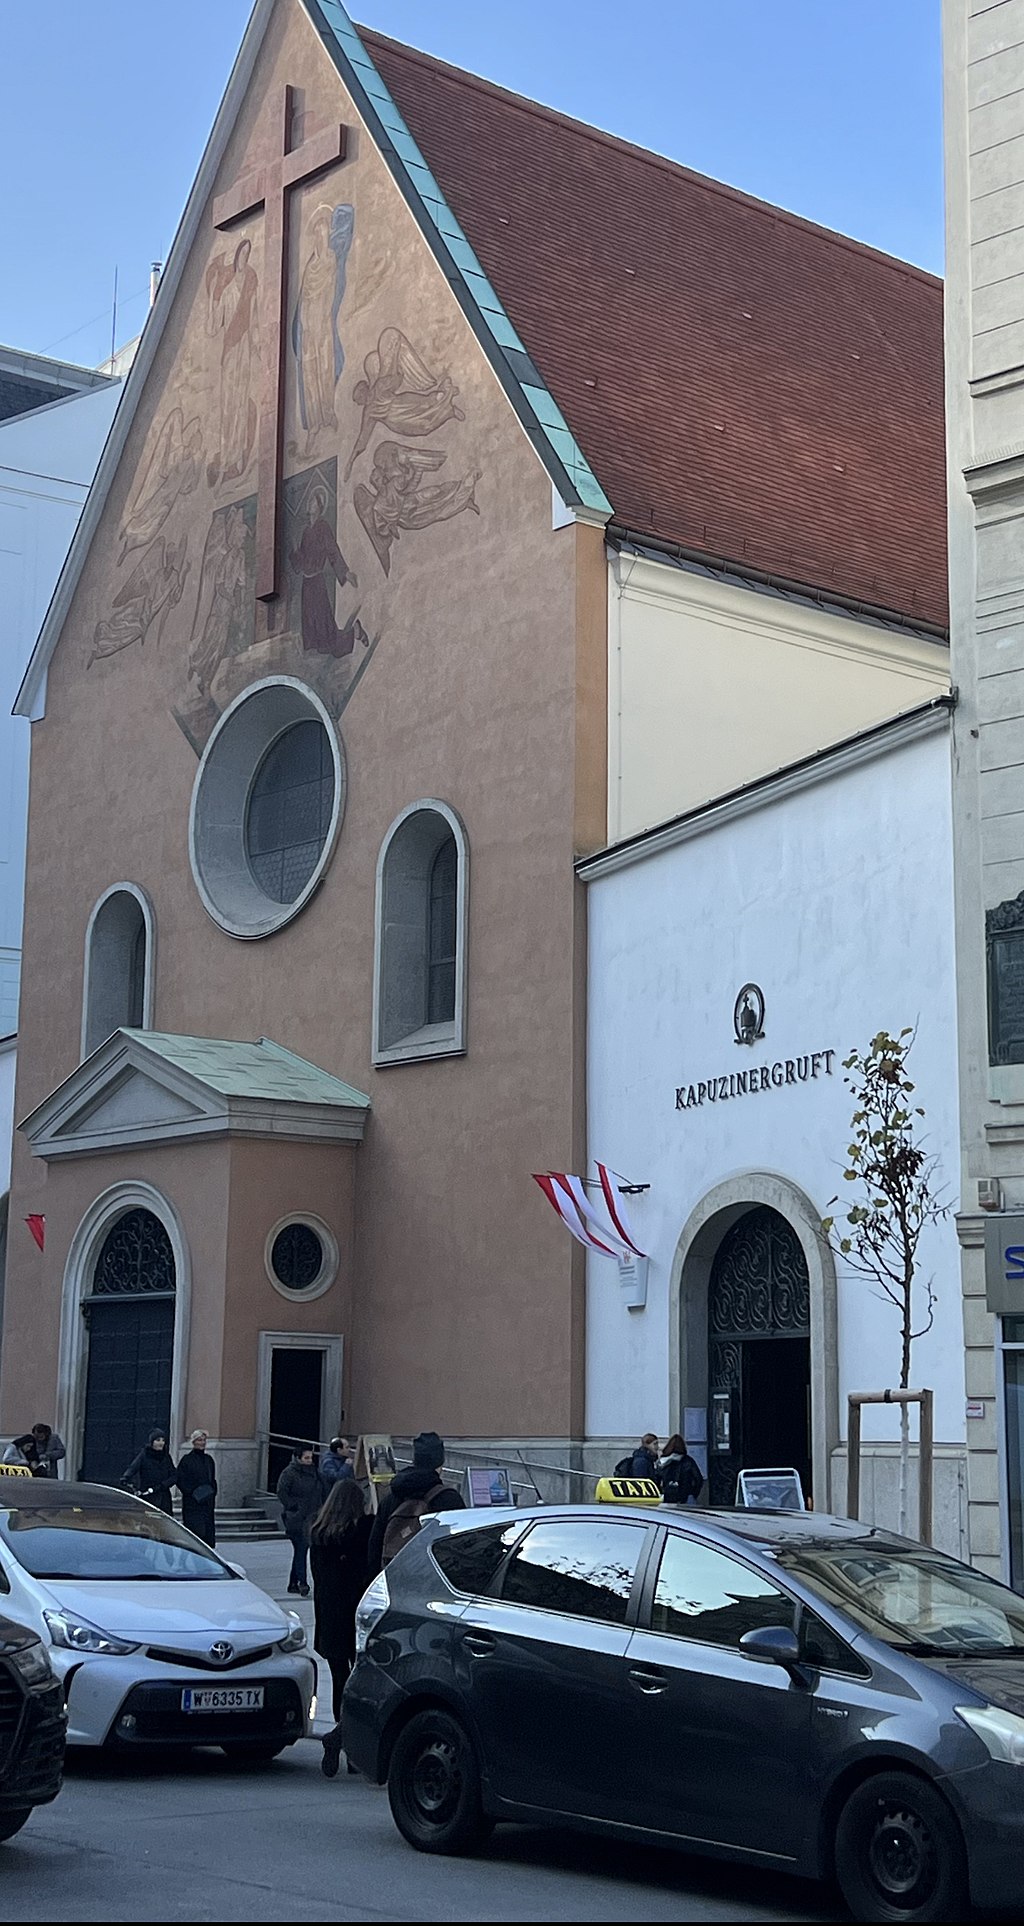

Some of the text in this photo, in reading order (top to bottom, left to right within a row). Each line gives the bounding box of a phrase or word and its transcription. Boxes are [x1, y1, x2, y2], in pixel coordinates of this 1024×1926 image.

[675, 1049, 836, 1111] KAPUZINERGRUFT
[1, 1467, 28, 1477] TAXI
[612, 1481, 657, 1496] TAXI
